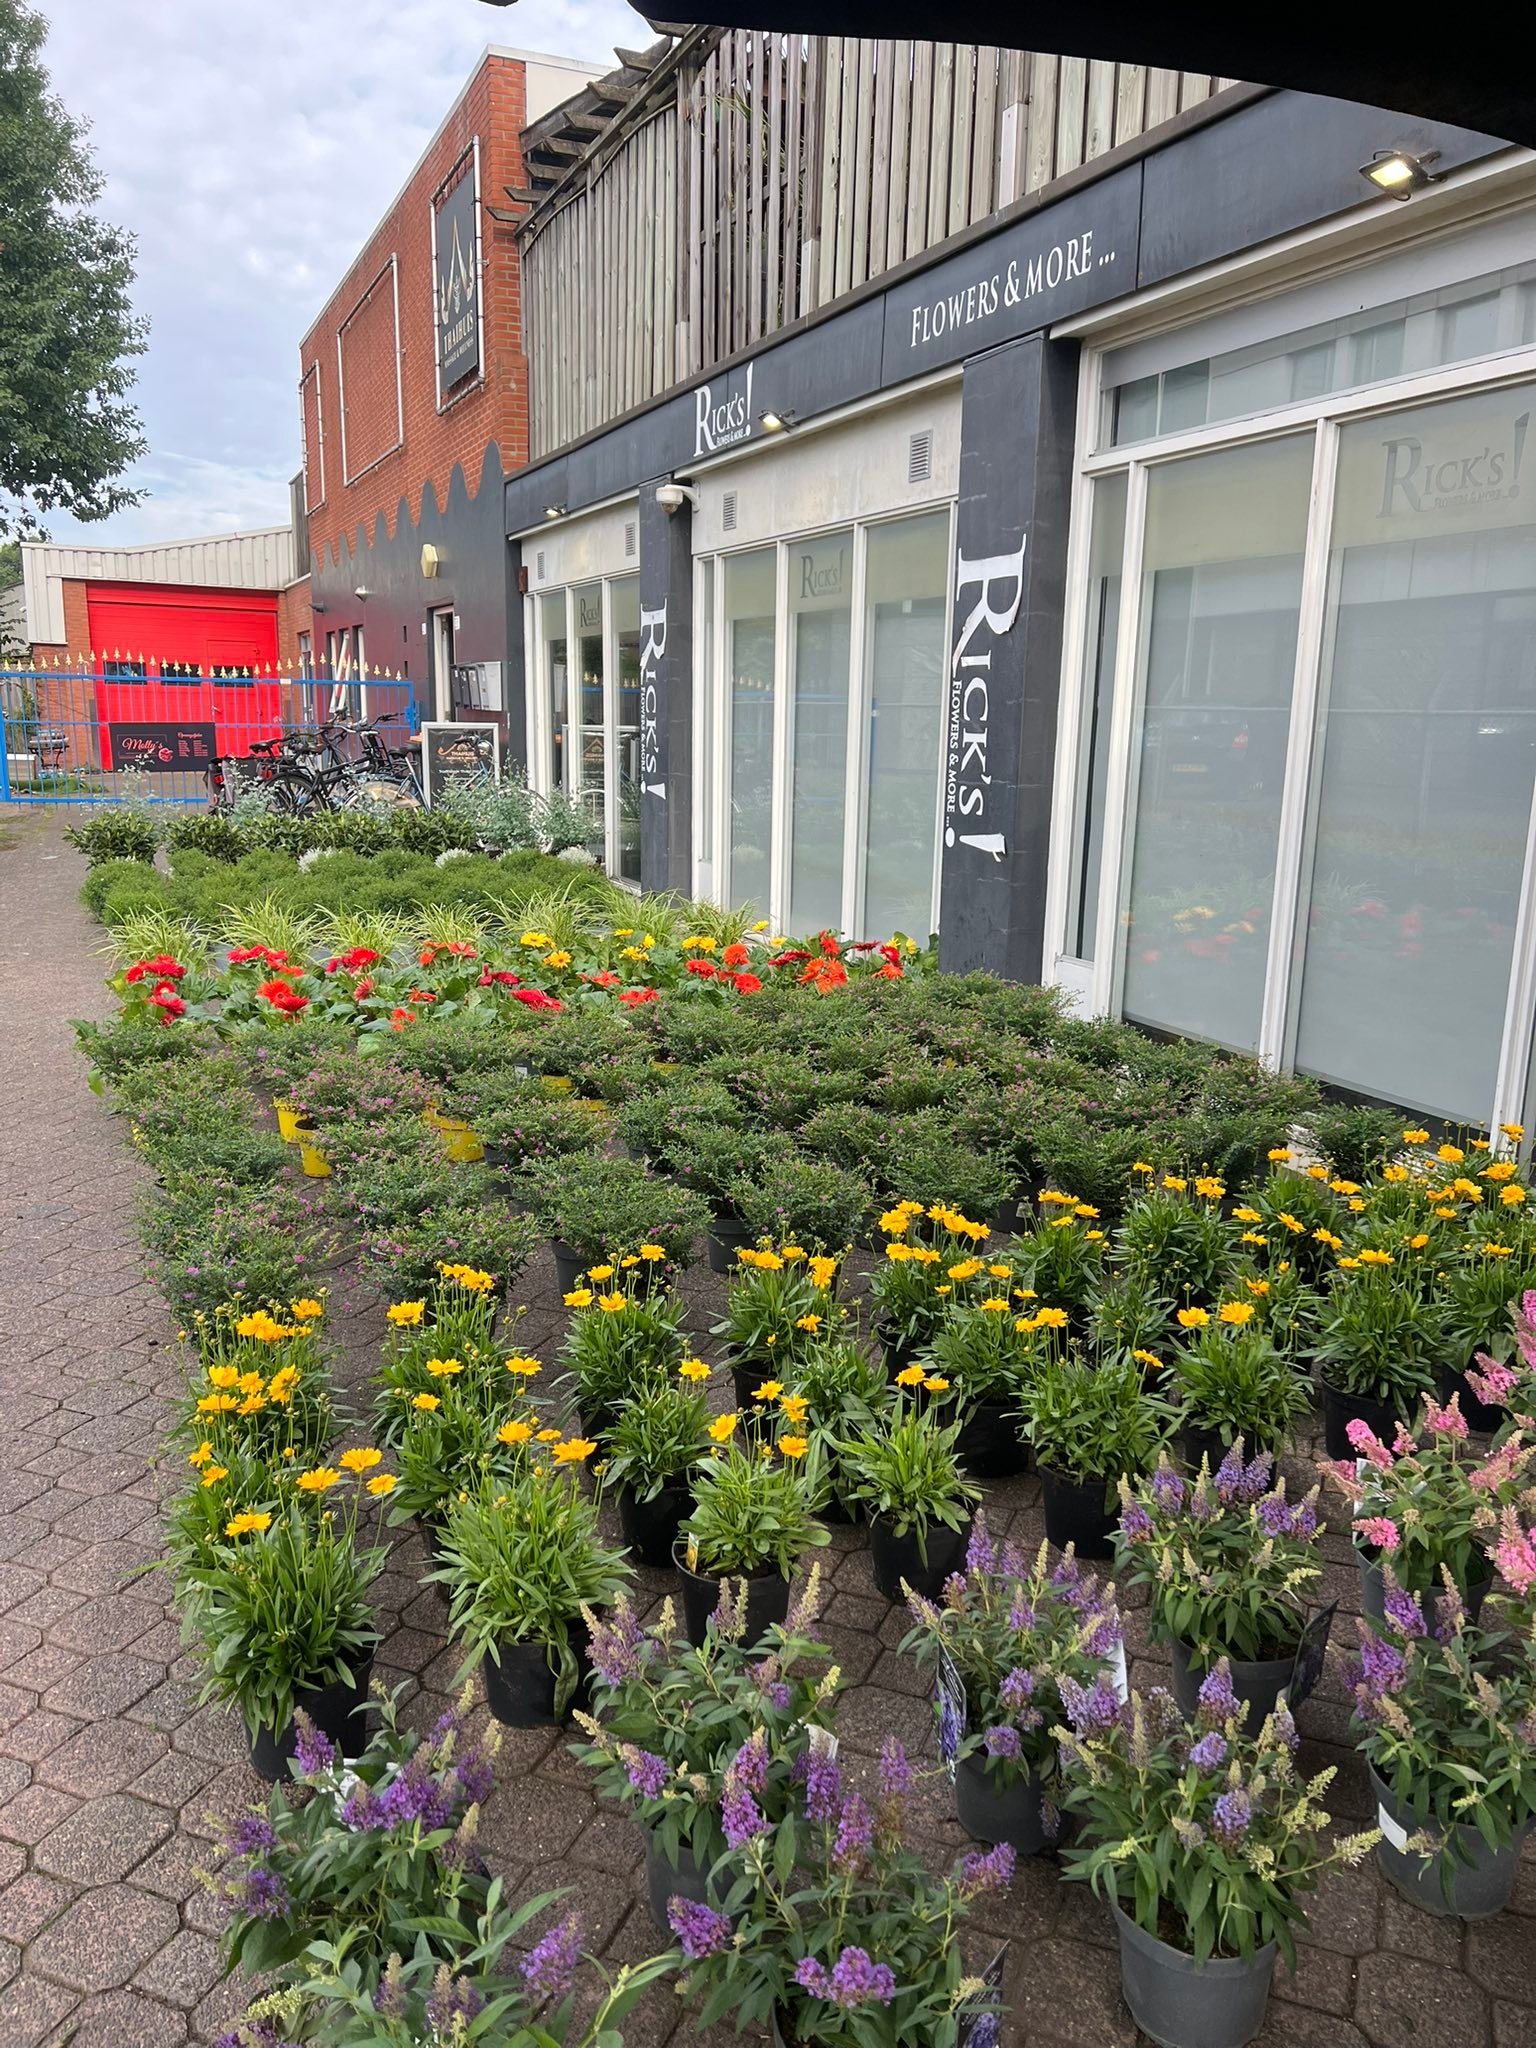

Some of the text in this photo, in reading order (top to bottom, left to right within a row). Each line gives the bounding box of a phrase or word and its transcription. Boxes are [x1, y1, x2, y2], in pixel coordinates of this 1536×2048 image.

[910, 275, 999, 348] FLOWERS
[1004, 260, 1021, 308] &
[693, 361, 753, 457] RICK'S!
[1375, 411, 1530, 519] RICK'S!
[799, 547, 844, 599] RICK'S!
[639, 598, 667, 800] RICK'S!
[945, 533, 1026, 863] RICK'S!
[949, 679, 963, 750] FLOWERS
[948, 753, 959, 766] &
